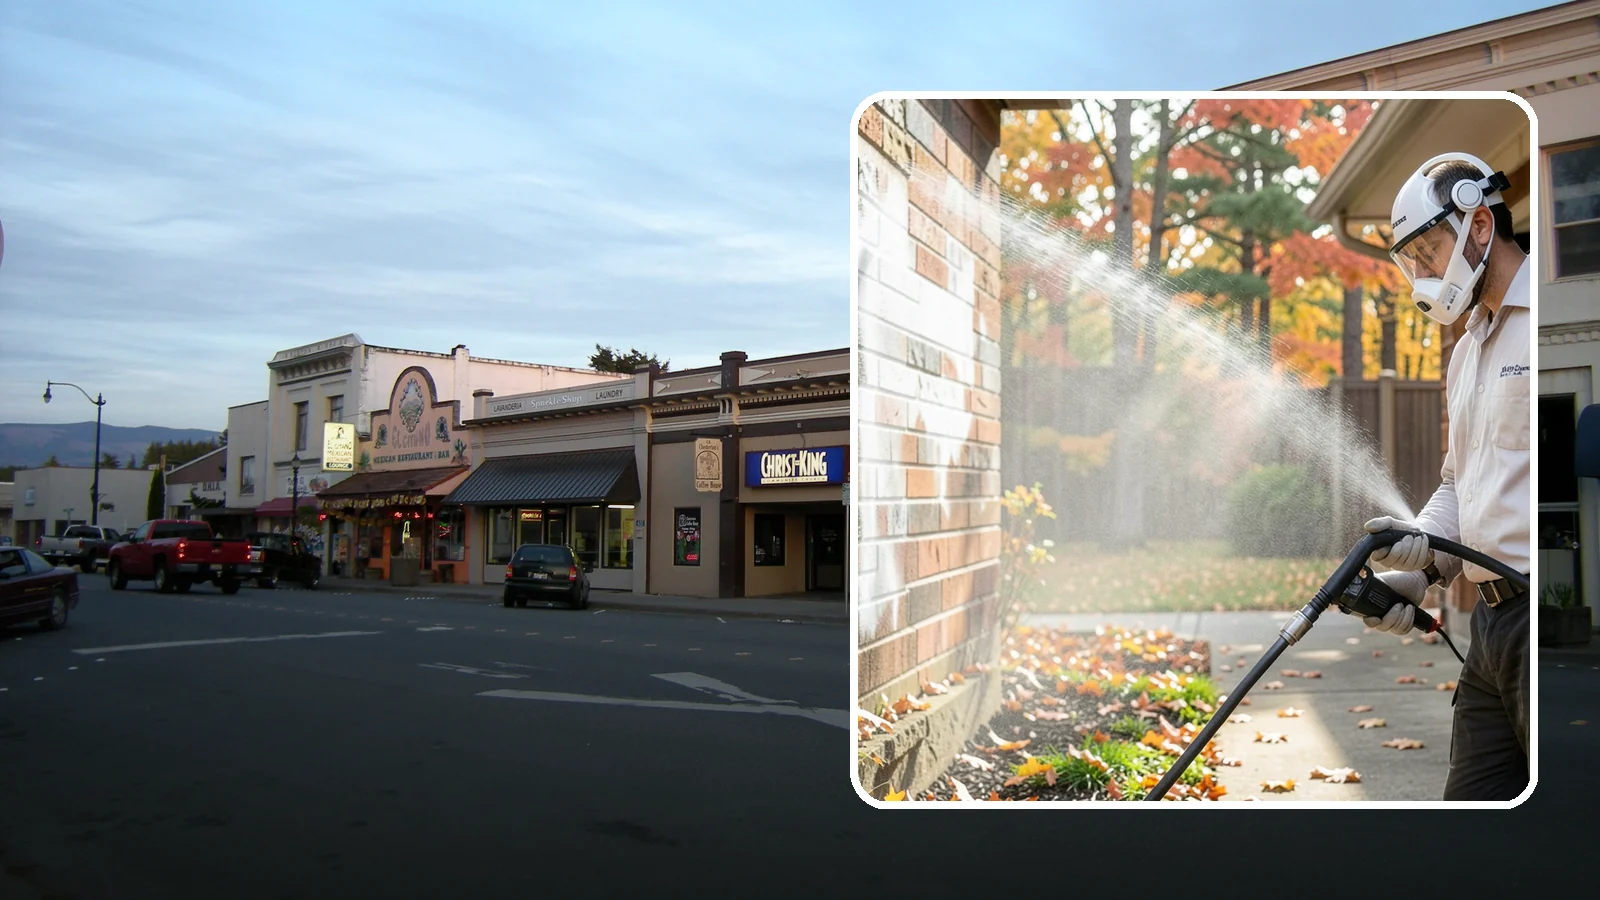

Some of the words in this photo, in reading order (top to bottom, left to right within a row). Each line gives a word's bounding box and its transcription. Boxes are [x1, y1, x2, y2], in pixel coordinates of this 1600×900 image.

[562, 394, 582, 406] Shop
[595, 389, 623, 400] LAUNDRY
[493, 402, 523, 413] LAVANDERIA
[373, 455, 396, 464] MEXICAN
[397, 451, 433, 462] RESTAURANT
[438, 450, 450, 459] BAR
[760, 452, 797, 478] CHRIST
[799, 450, 827, 476] KING
[696, 480, 709, 489] Coffee
[710, 480, 721, 489] House
